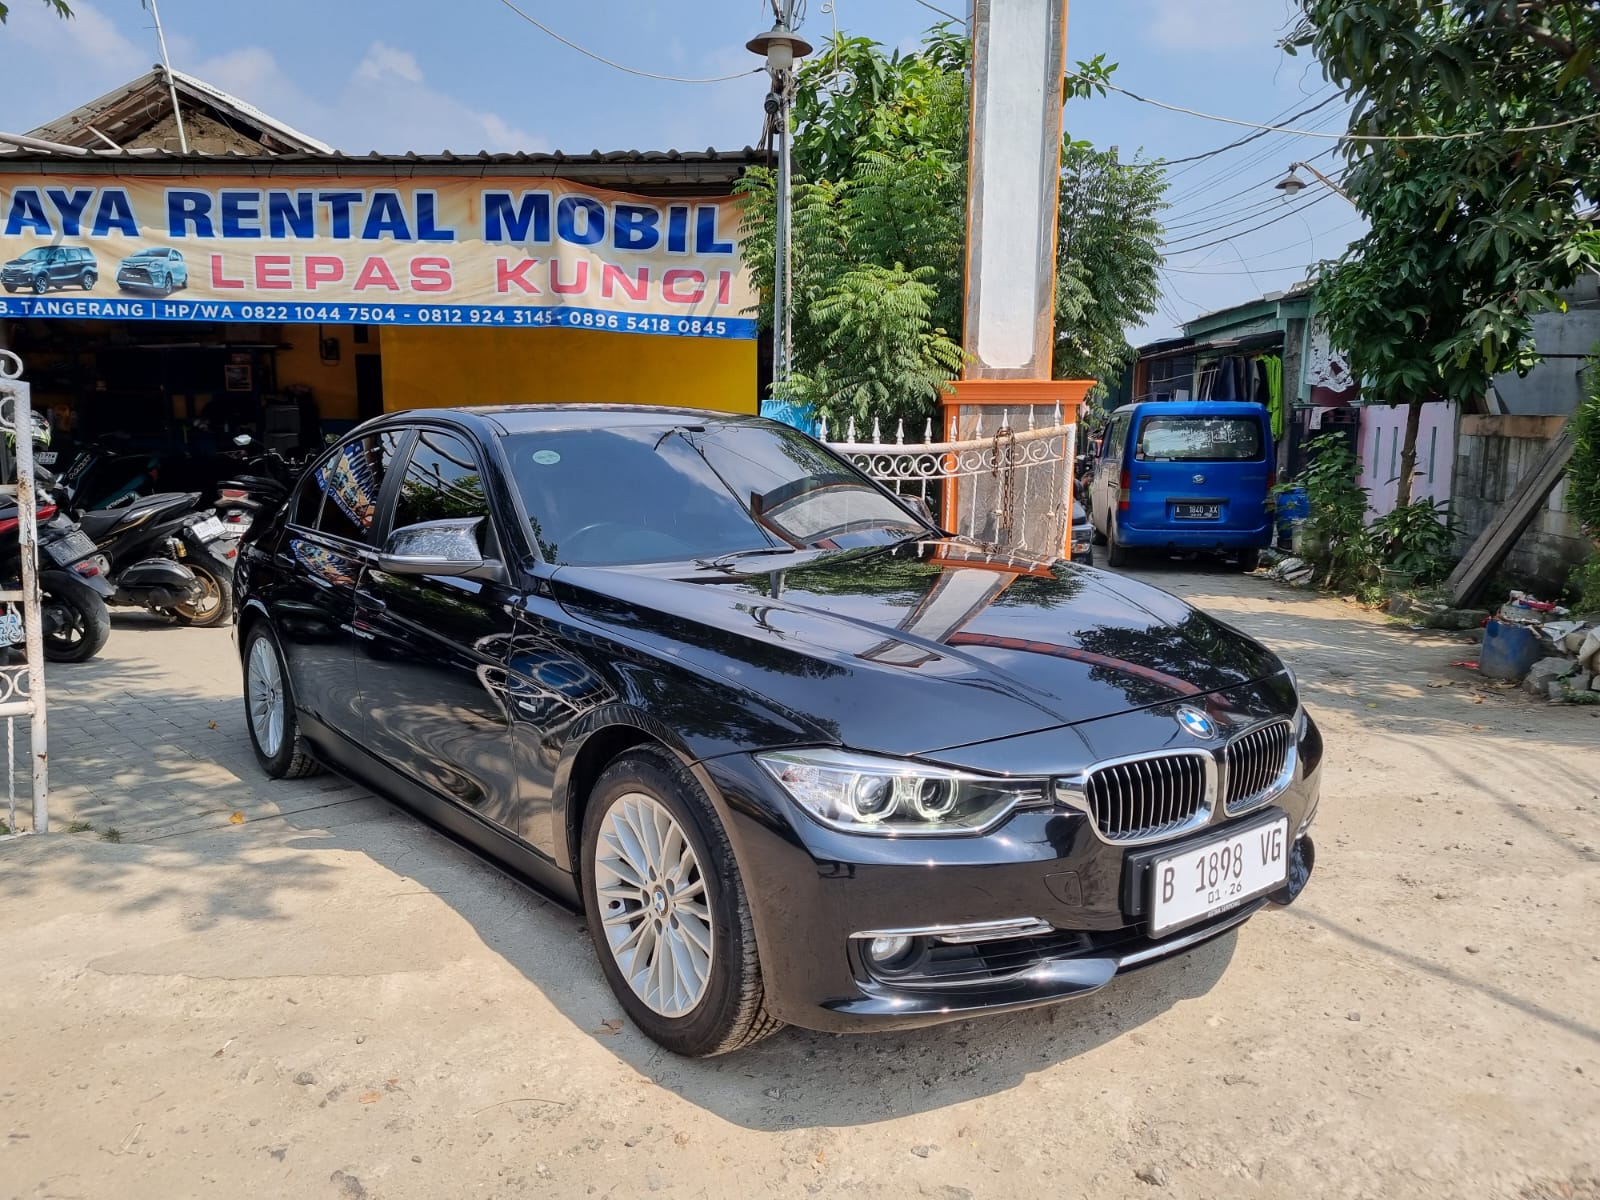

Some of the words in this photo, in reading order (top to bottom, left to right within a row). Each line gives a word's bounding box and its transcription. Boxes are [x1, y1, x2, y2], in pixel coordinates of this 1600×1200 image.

[4, 190, 139, 237] AYA
[167, 191, 455, 241] RENTAL
[484, 193, 733, 254] MOBIL
[211, 255, 452, 291] LEPAS
[496, 258, 731, 305] KUNCI
[20, 301, 144, 317] TANGERANG
[165, 303, 234, 320] HP/WA
[241, 306, 288, 320] 0822
[295, 306, 341, 320] 1044
[348, 307, 396, 321] 7504
[418, 308, 462, 322] 0812
[470, 309, 505, 323] 924
[513, 310, 552, 324] 3145
[569, 311, 618, 329] 0896
[626, 316, 670, 332] 5418
[677, 319, 726, 335] 0845
[1162, 866, 1176, 905] B
[1195, 842, 1243, 893] 1898
[1260, 827, 1283, 867] VG
